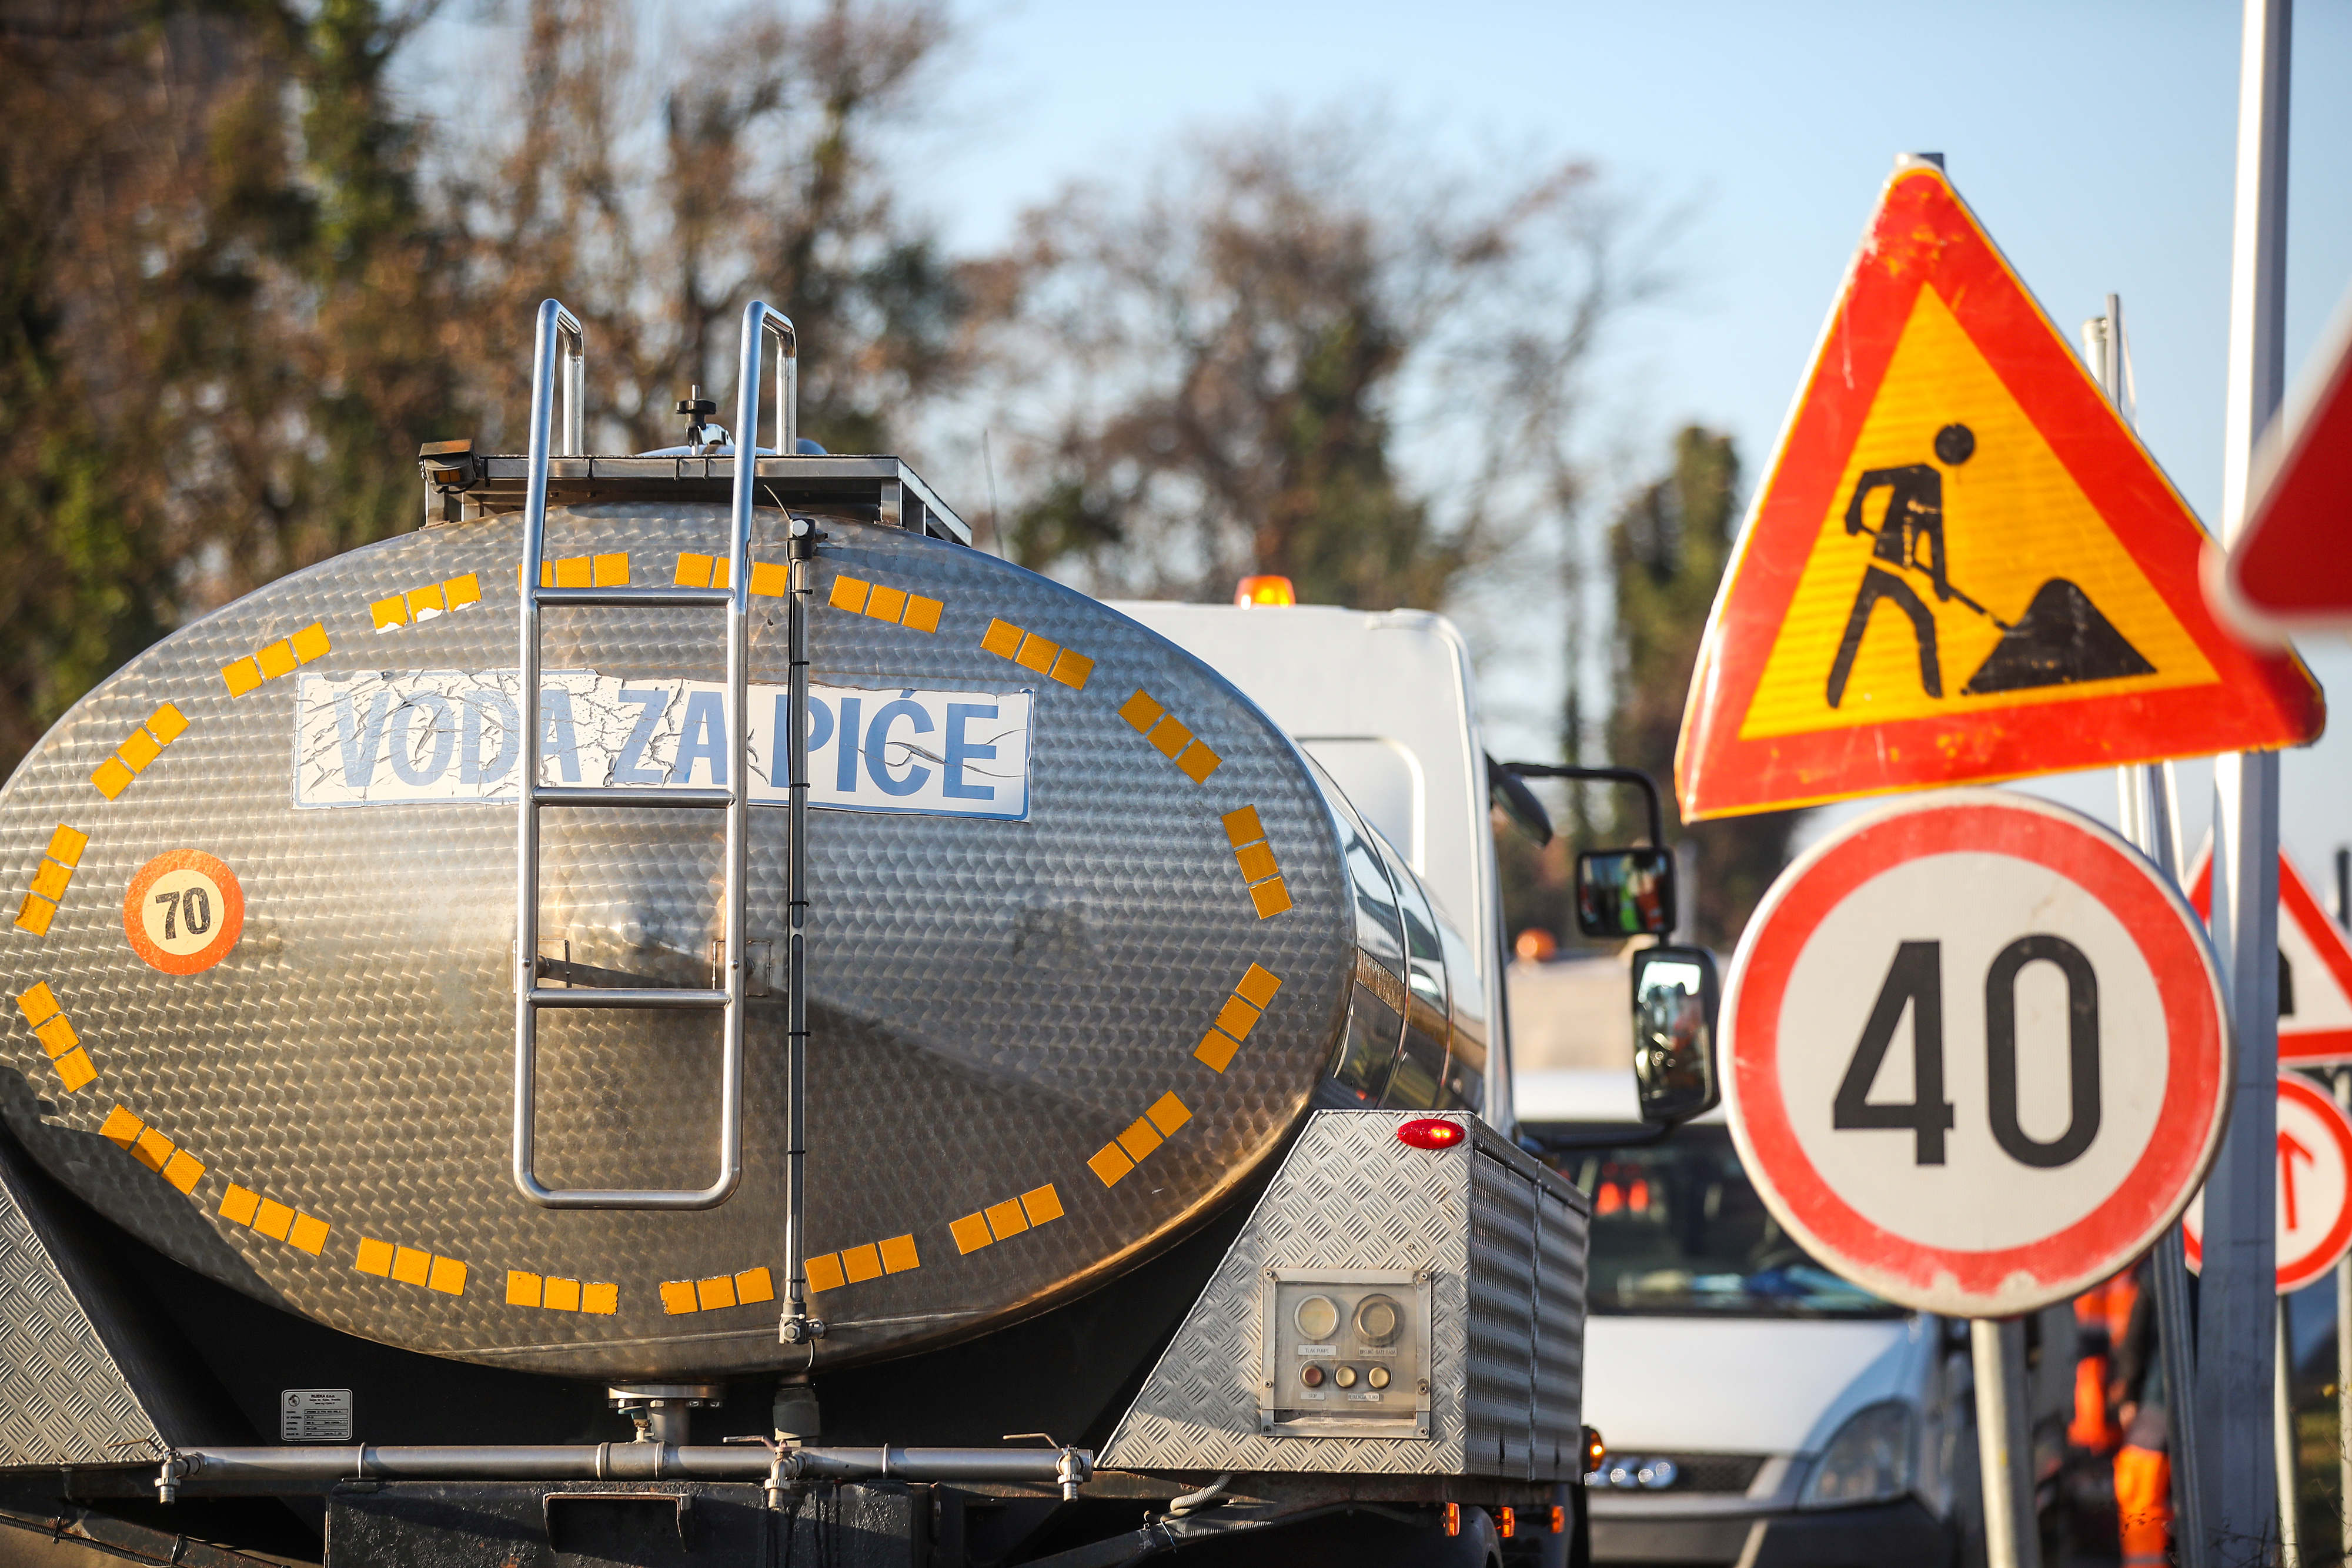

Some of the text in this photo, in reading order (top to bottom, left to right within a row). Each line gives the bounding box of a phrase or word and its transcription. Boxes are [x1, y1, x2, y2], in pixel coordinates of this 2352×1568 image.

[332, 687, 1000, 801] VODA ZA PIĆE
[155, 887, 211, 940] 70
[1832, 933, 2102, 1169] 40
